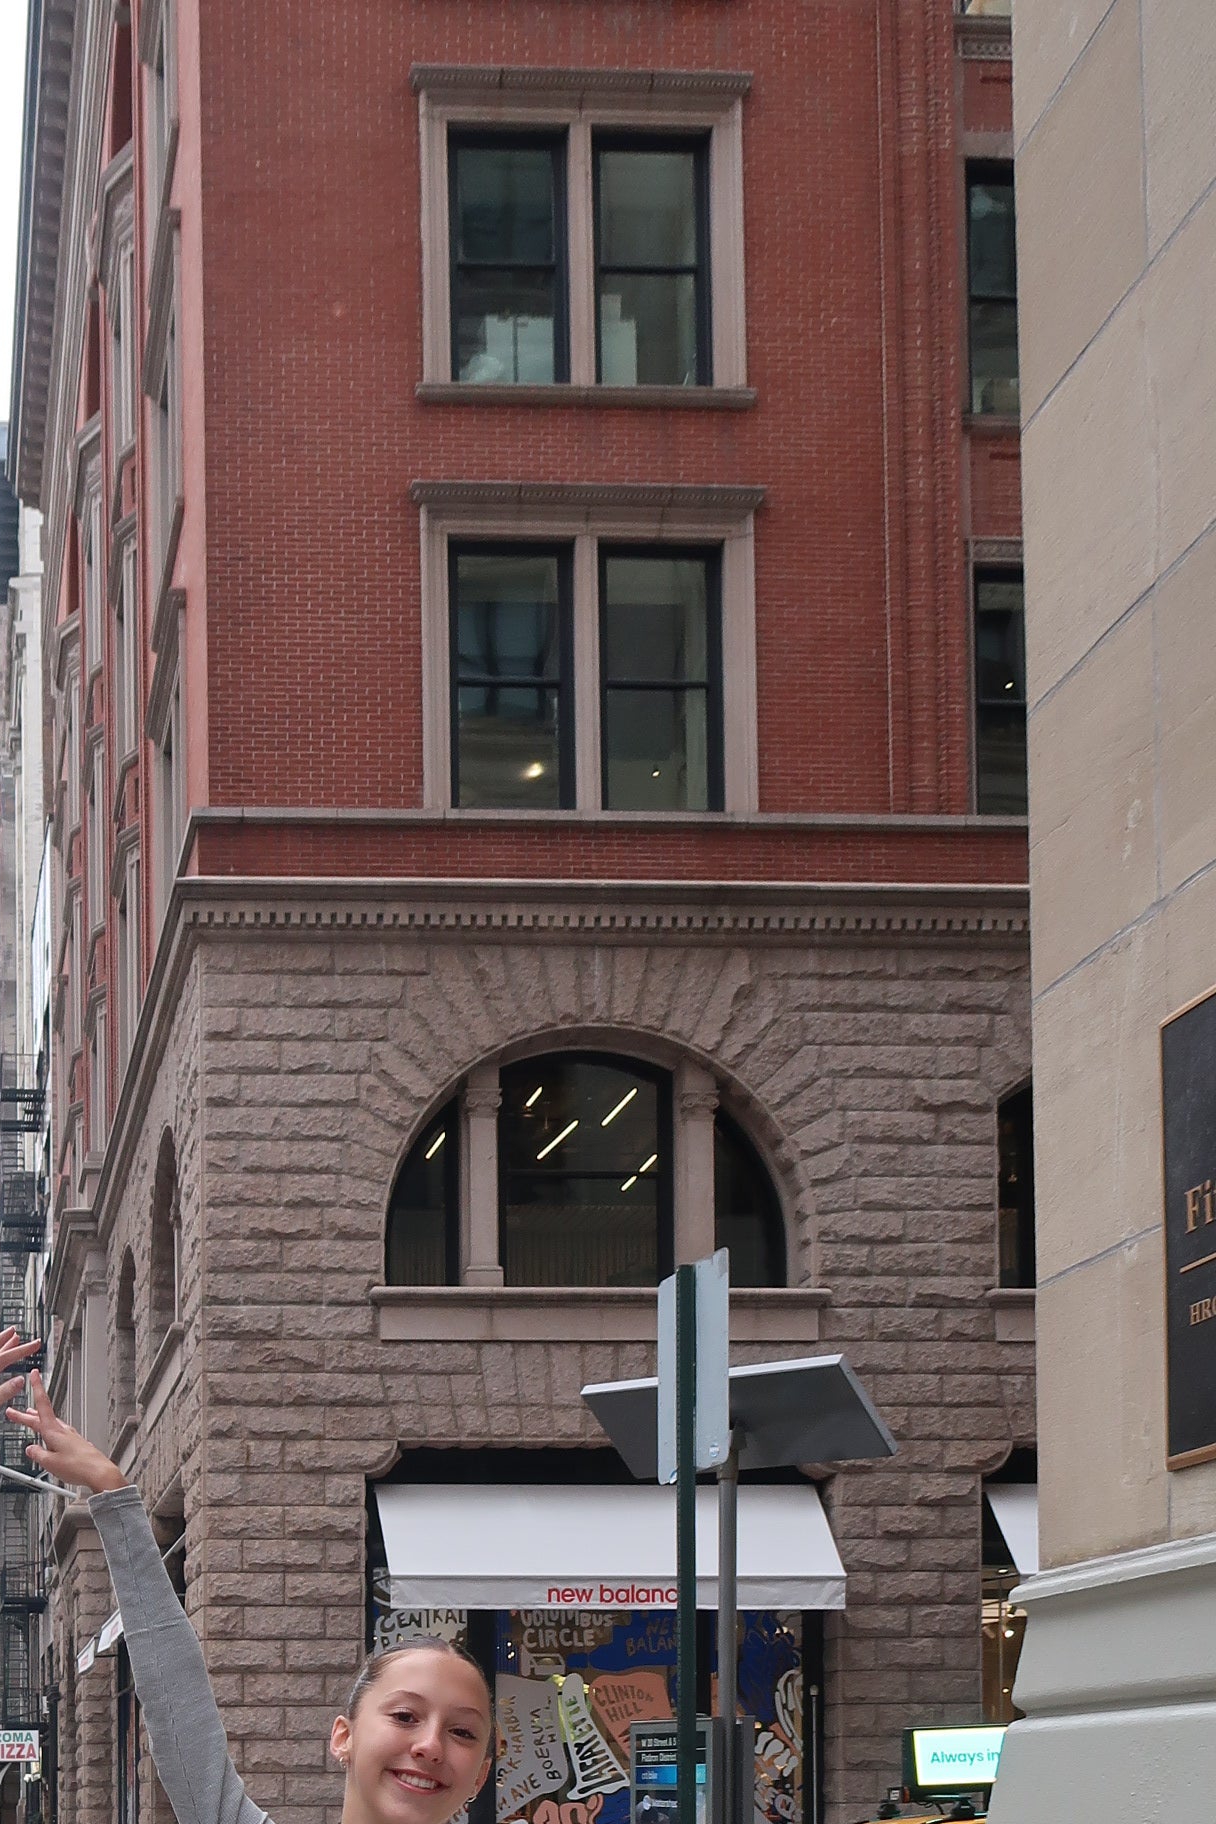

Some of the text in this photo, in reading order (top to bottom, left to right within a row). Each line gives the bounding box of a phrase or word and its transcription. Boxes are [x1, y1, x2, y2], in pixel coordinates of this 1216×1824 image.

[1184, 1179, 1216, 1234] Fi
[547, 1584, 677, 1604] new balanc
[380, 1609, 467, 1633] CENTRAL
[522, 1628, 596, 1648] CIRCLE
[626, 1636, 677, 1657] BALAN
[593, 1684, 654, 1708] CLINTON
[605, 1702, 643, 1722] HILL
[530, 1708, 562, 1781] BOERUM
[565, 1695, 626, 1795] LAFAYETTE
[931, 1751, 984, 1767] Always
[511, 1772, 541, 1802] AVE
